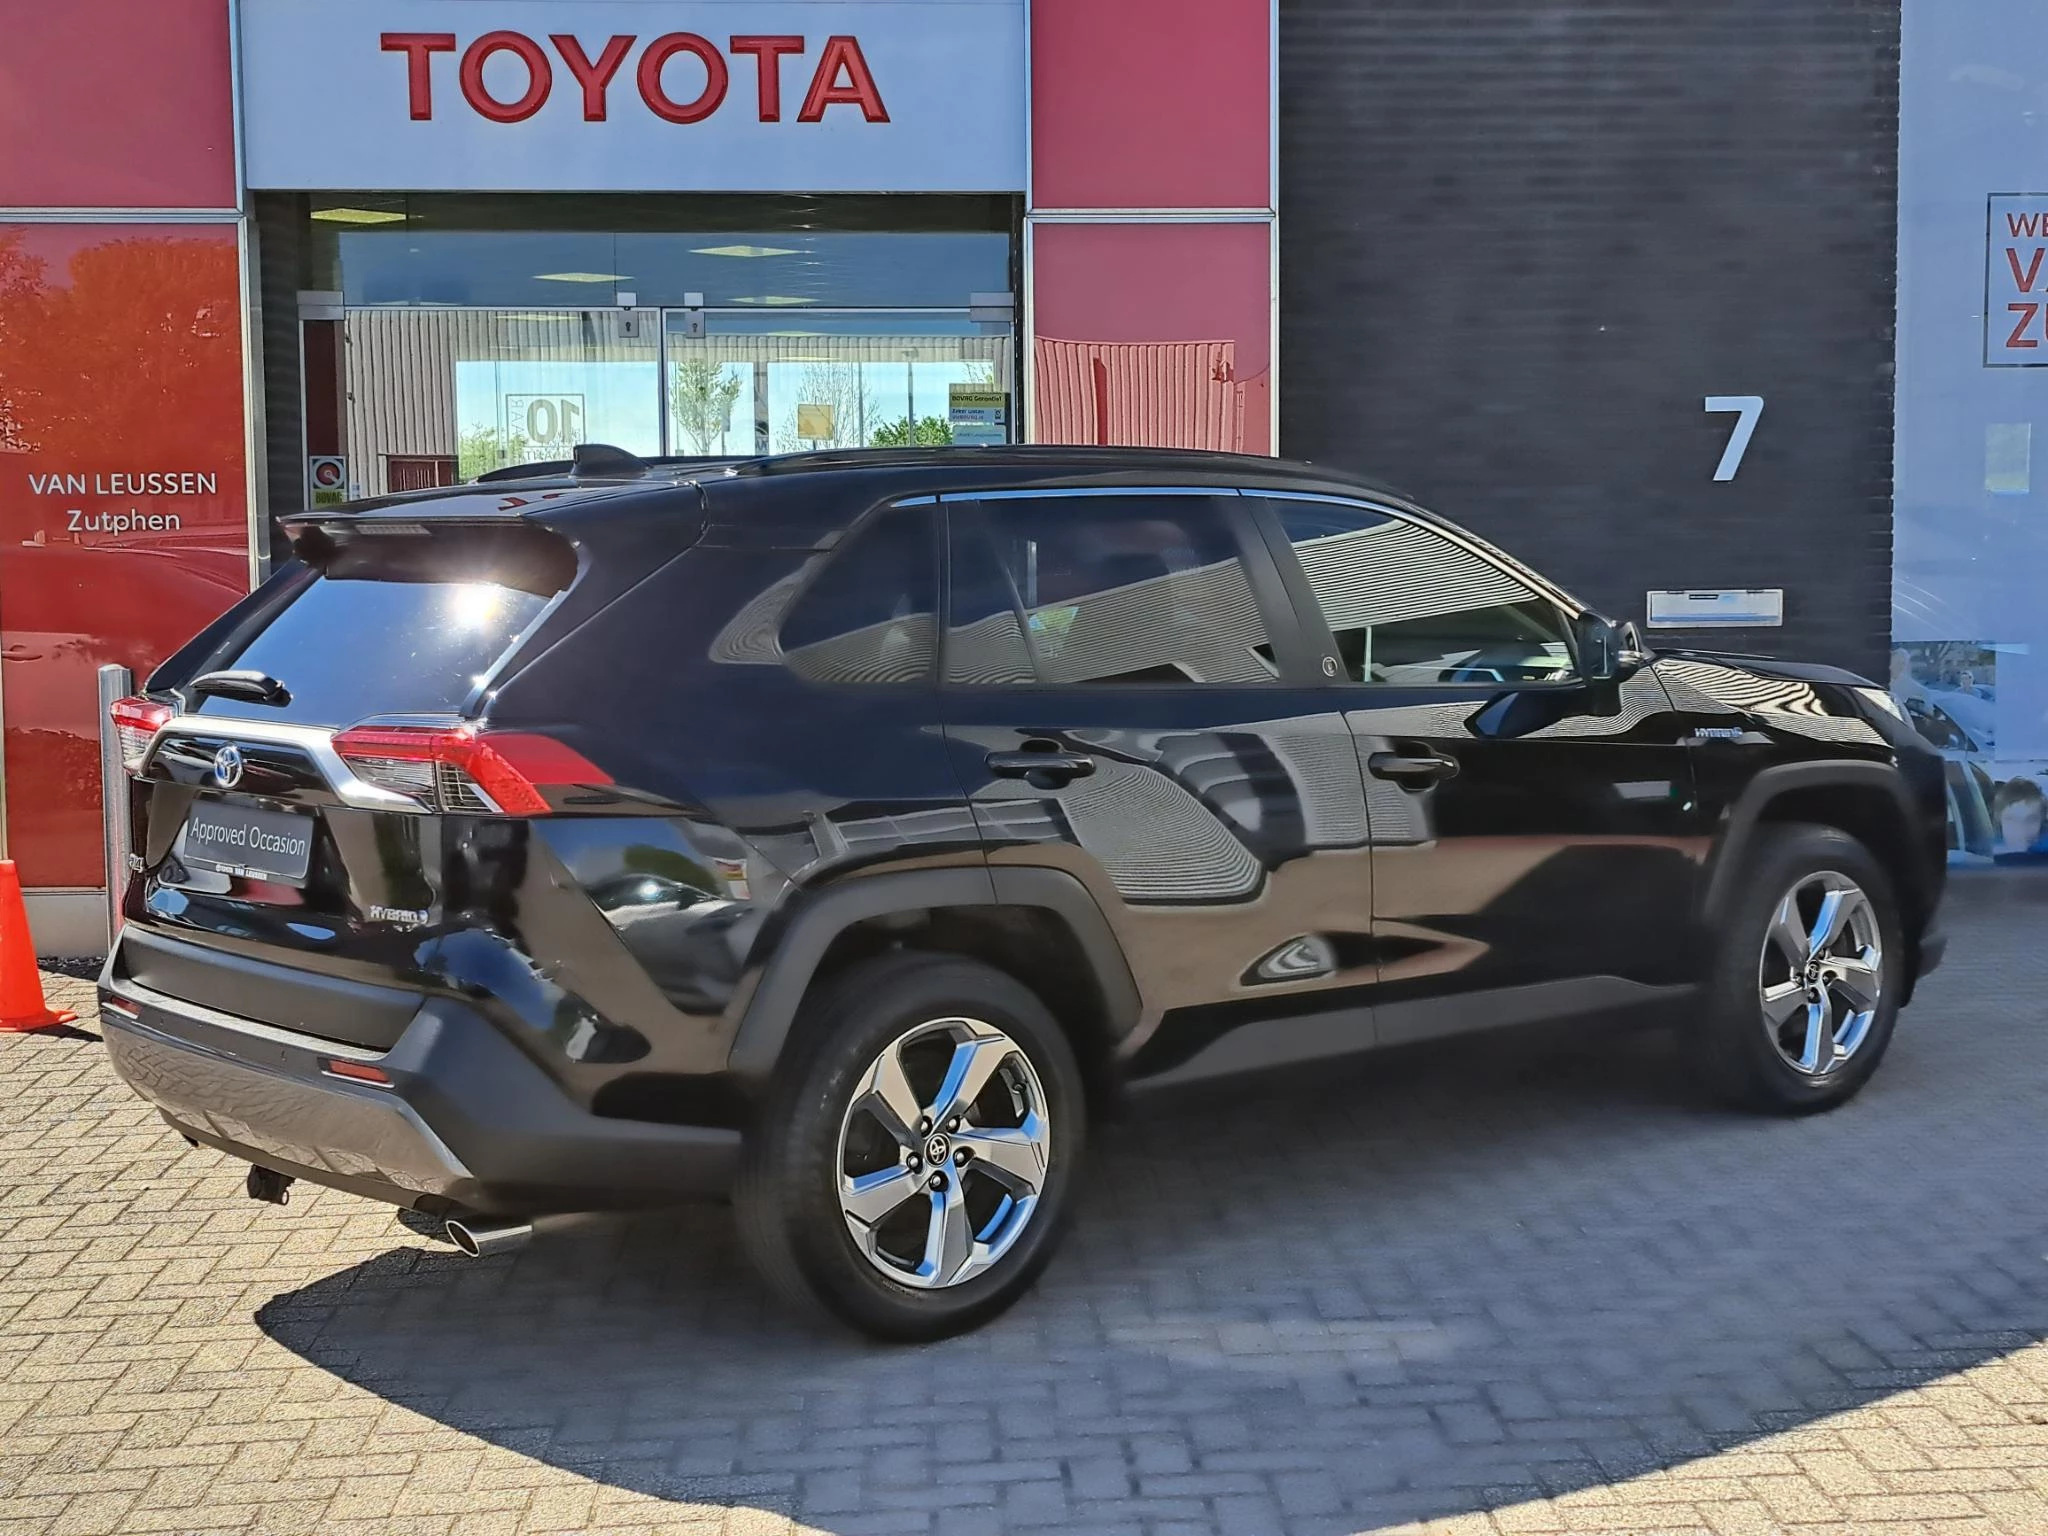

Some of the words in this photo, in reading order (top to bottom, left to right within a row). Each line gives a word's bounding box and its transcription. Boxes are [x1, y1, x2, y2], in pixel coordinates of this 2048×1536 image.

[380, 30, 891, 124] TOYOTA
[2006, 247, 2048, 293] V
[2006, 303, 2048, 347] Z
[1704, 396, 1764, 481] 7
[28, 473, 86, 495] VAN
[95, 472, 217, 495] LEUSSEN
[66, 508, 181, 537] Zutphen
[190, 816, 247, 846] Approved
[249, 826, 306, 857] Occasion
